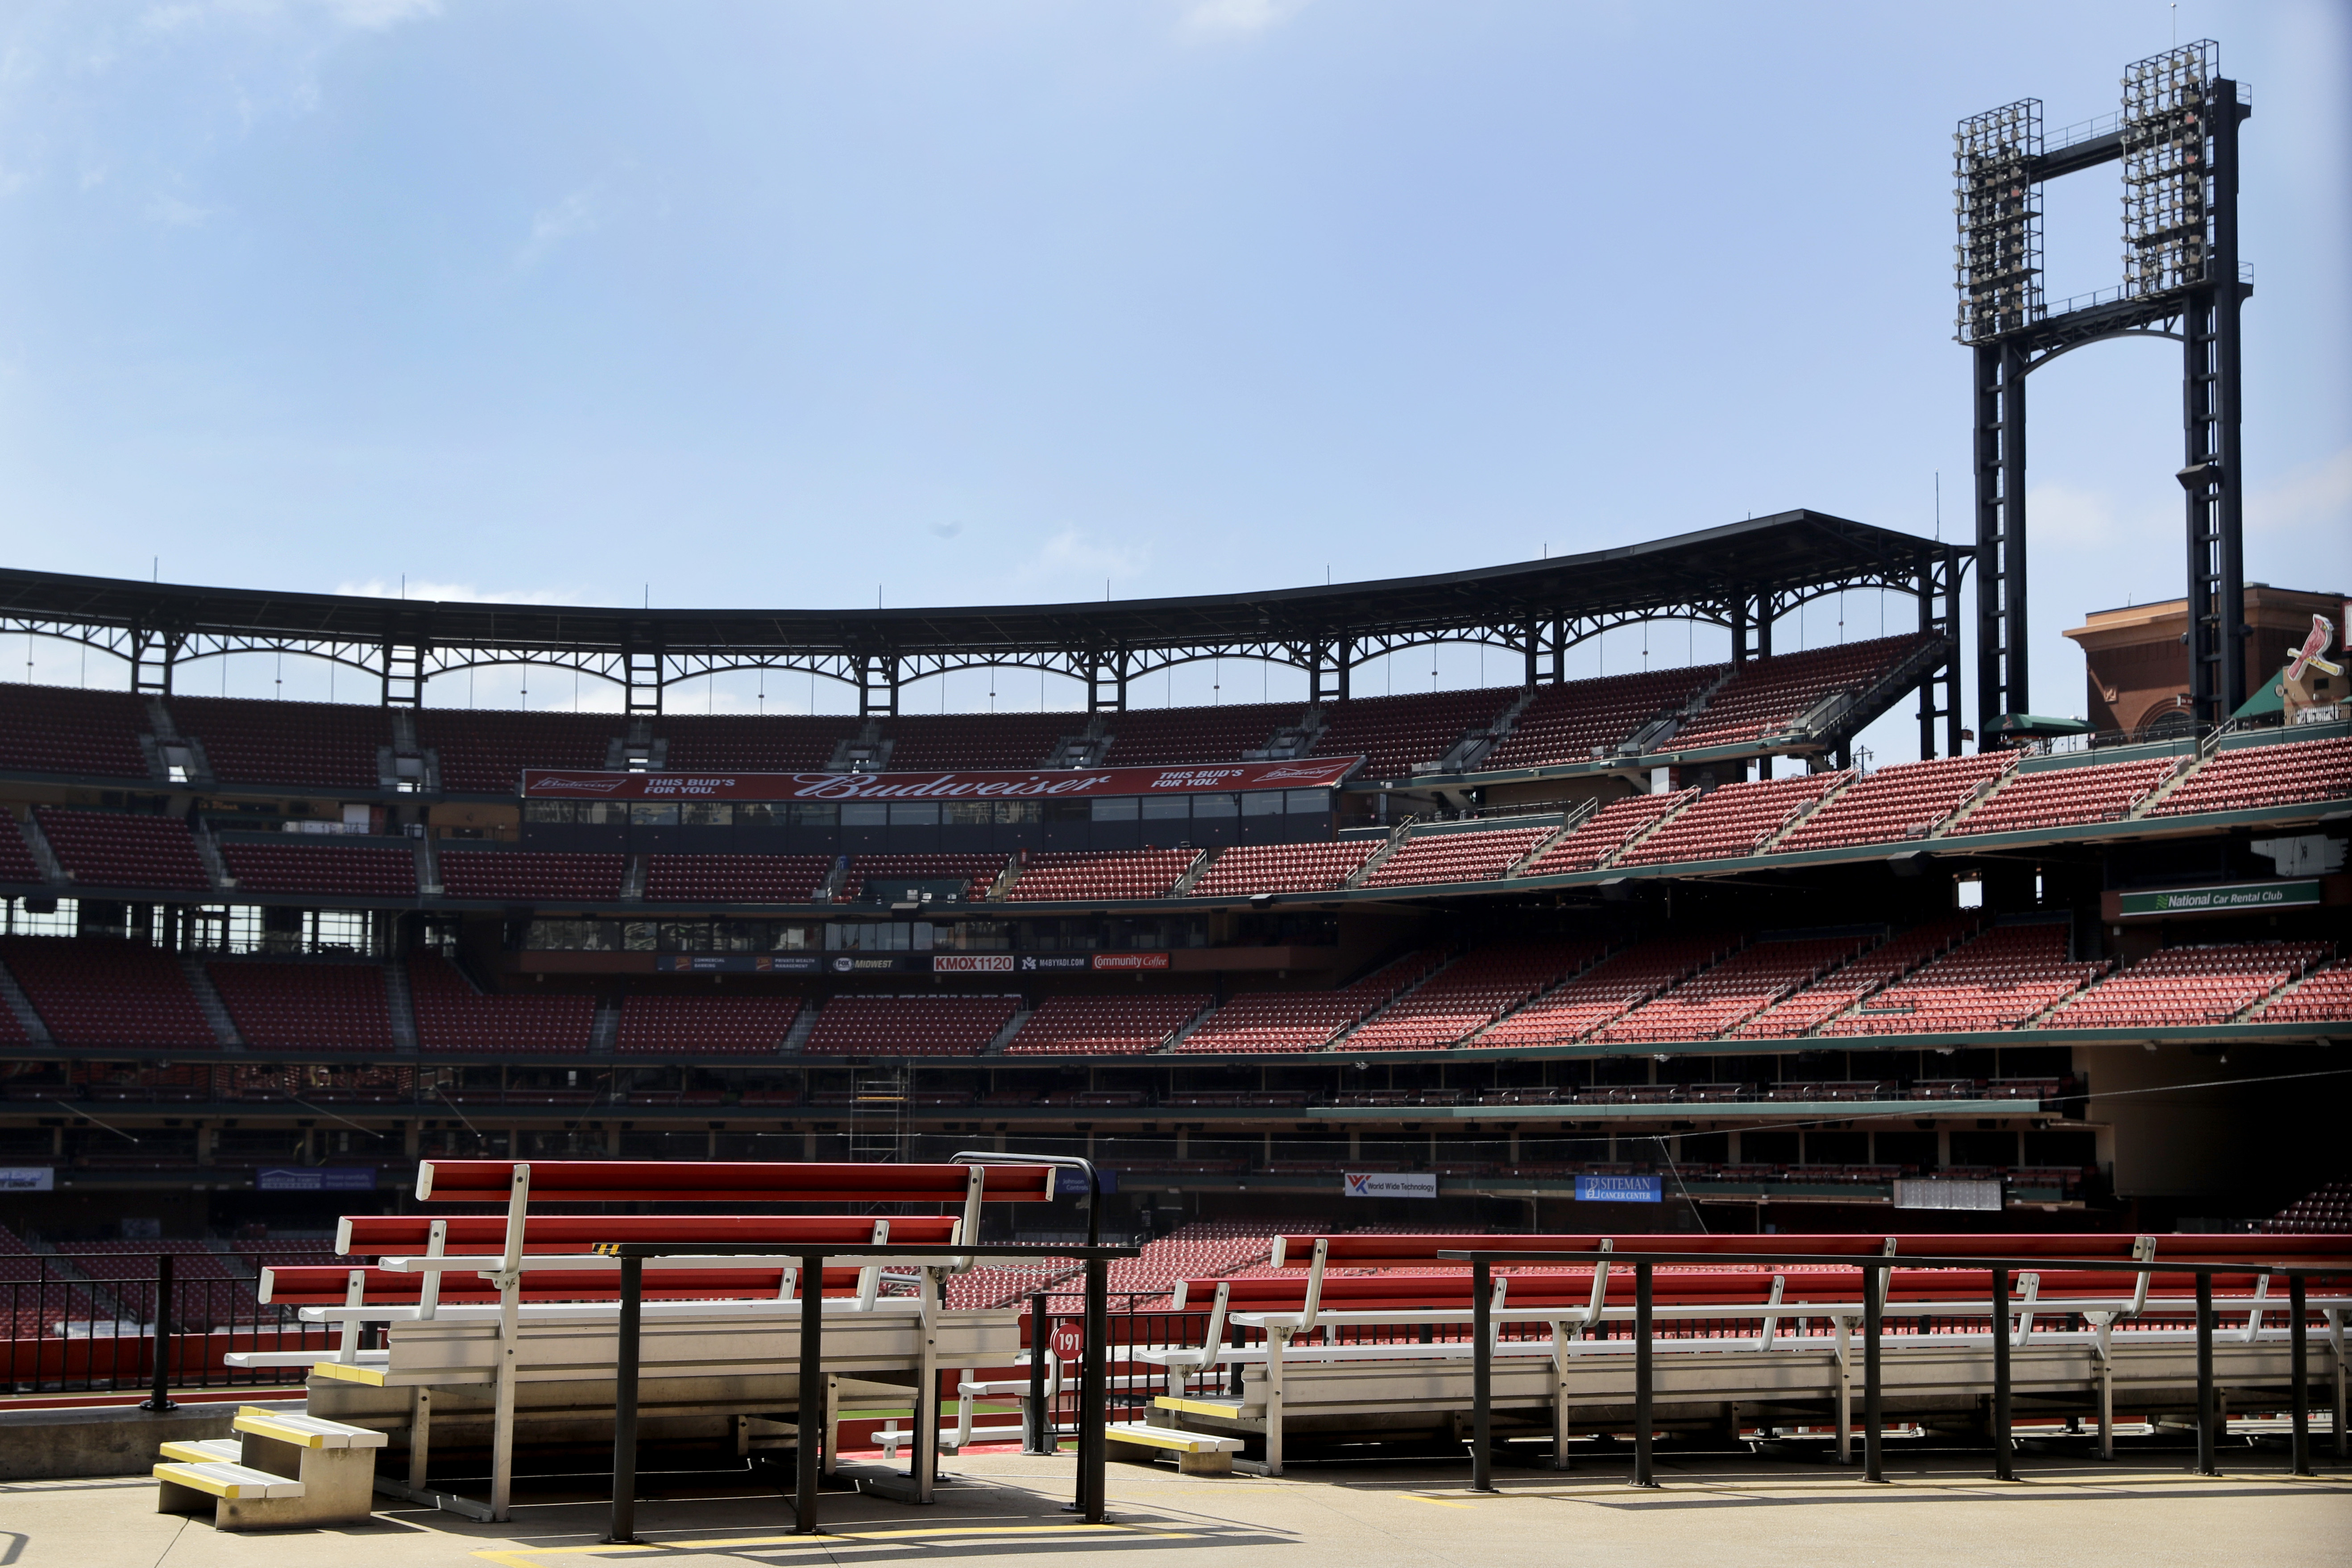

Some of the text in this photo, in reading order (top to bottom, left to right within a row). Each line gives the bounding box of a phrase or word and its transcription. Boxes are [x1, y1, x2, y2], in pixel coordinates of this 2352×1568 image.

[1159, 769, 1244, 780] THIS BUD'S
[1265, 768, 1336, 778] Budweiser
[541, 778, 616, 788] Budweiser
[687, 779, 735, 787] BUD'S
[792, 773, 1112, 799] Budweiser
[1150, 778, 1219, 788] FOR YOU.
[2168, 891, 2282, 908] National Car Rental Club
[854, 960, 893, 968] MIDWEST
[1039, 958, 1084, 967] M4BYYADI.COM
[1095, 955, 1167, 968] Community Coffee
[1401, 1183, 1435, 1192] Technology
[1601, 1178, 1651, 1190] SITEMAN
[1059, 1333, 1079, 1351] 191
